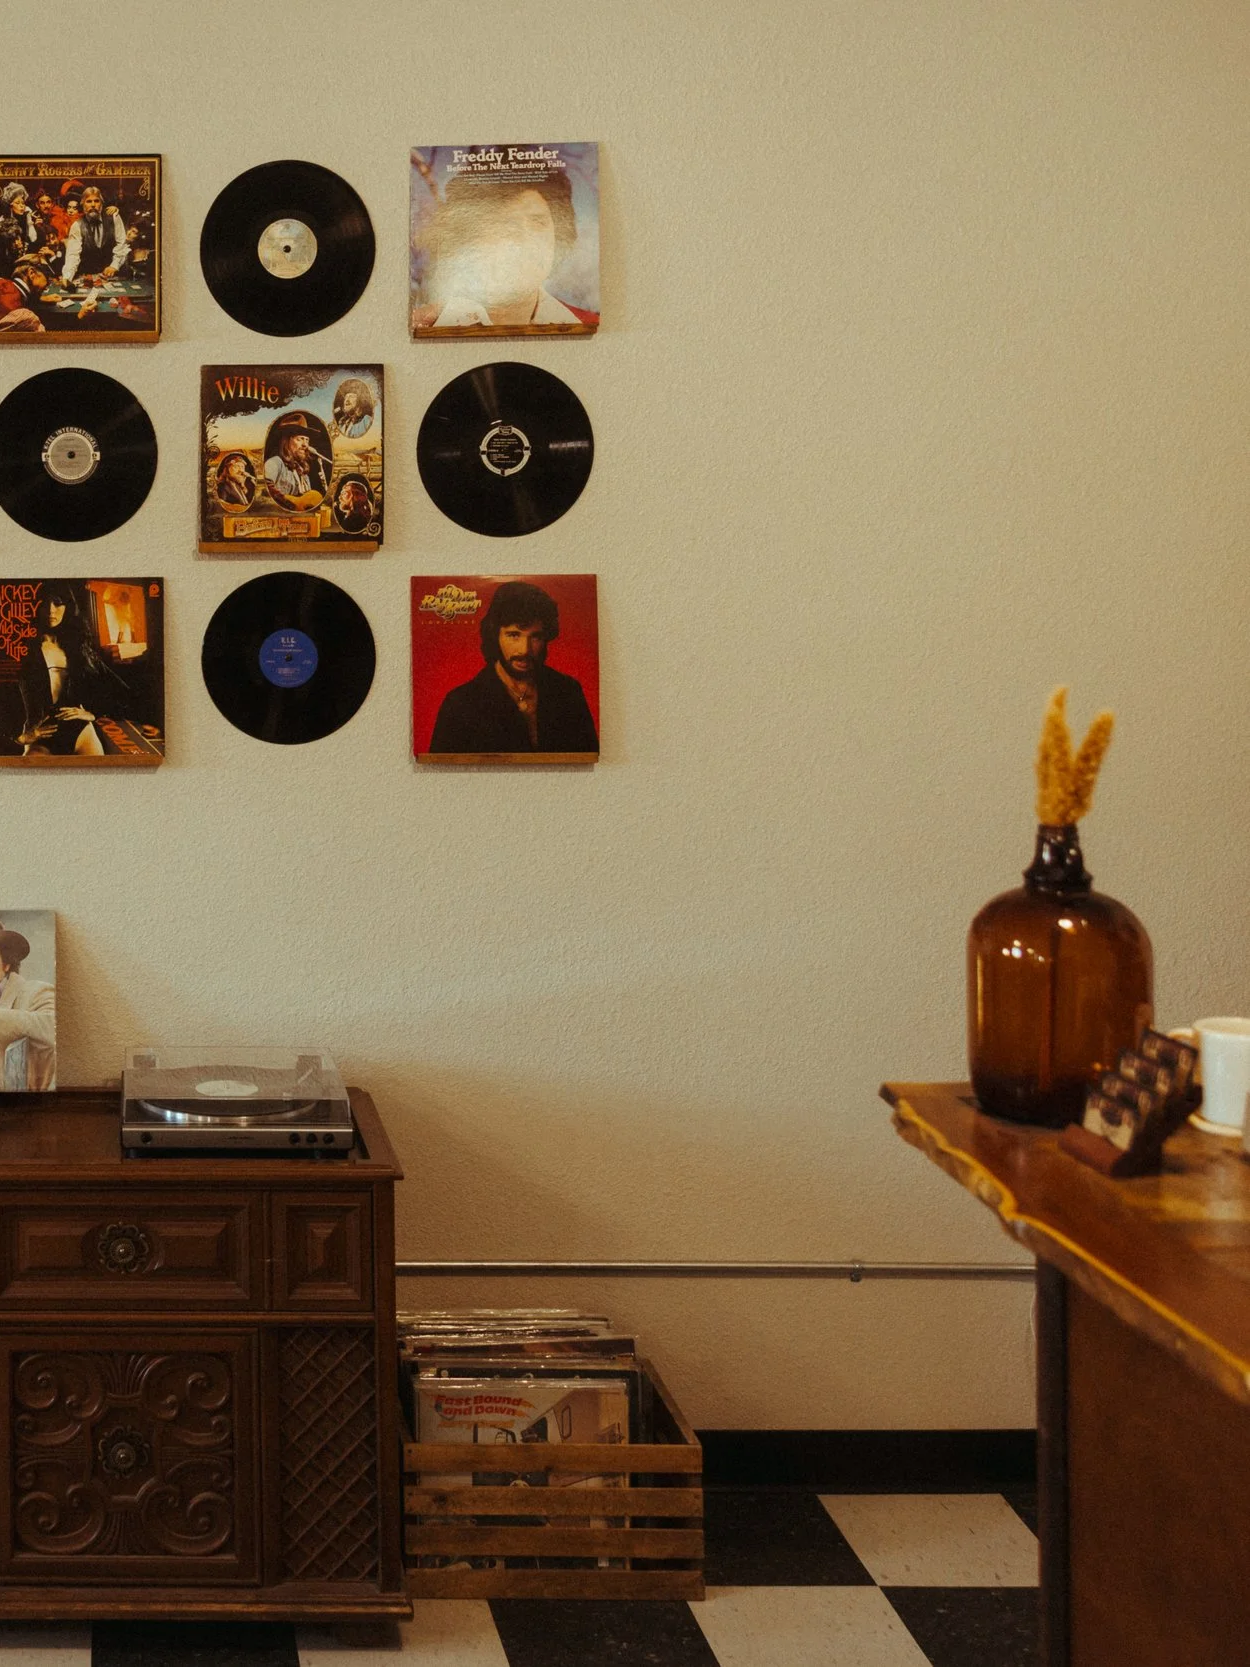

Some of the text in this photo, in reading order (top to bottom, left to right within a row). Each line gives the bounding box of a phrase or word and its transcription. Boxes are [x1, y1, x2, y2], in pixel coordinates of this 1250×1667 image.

[453, 146, 559, 164] Freddy Fender
[446, 160, 567, 172] Before The Next Teardrop Falls
[215, 376, 280, 404] Willie
[55, 426, 99, 449] INTERNATIONAL
[0, 600, 43, 623] GILLEY
[12, 623, 38, 644] Side
[9, 641, 28, 662] Life
[443, 1405, 517, 1416] and Down
[473, 1395, 523, 1406] Bound
